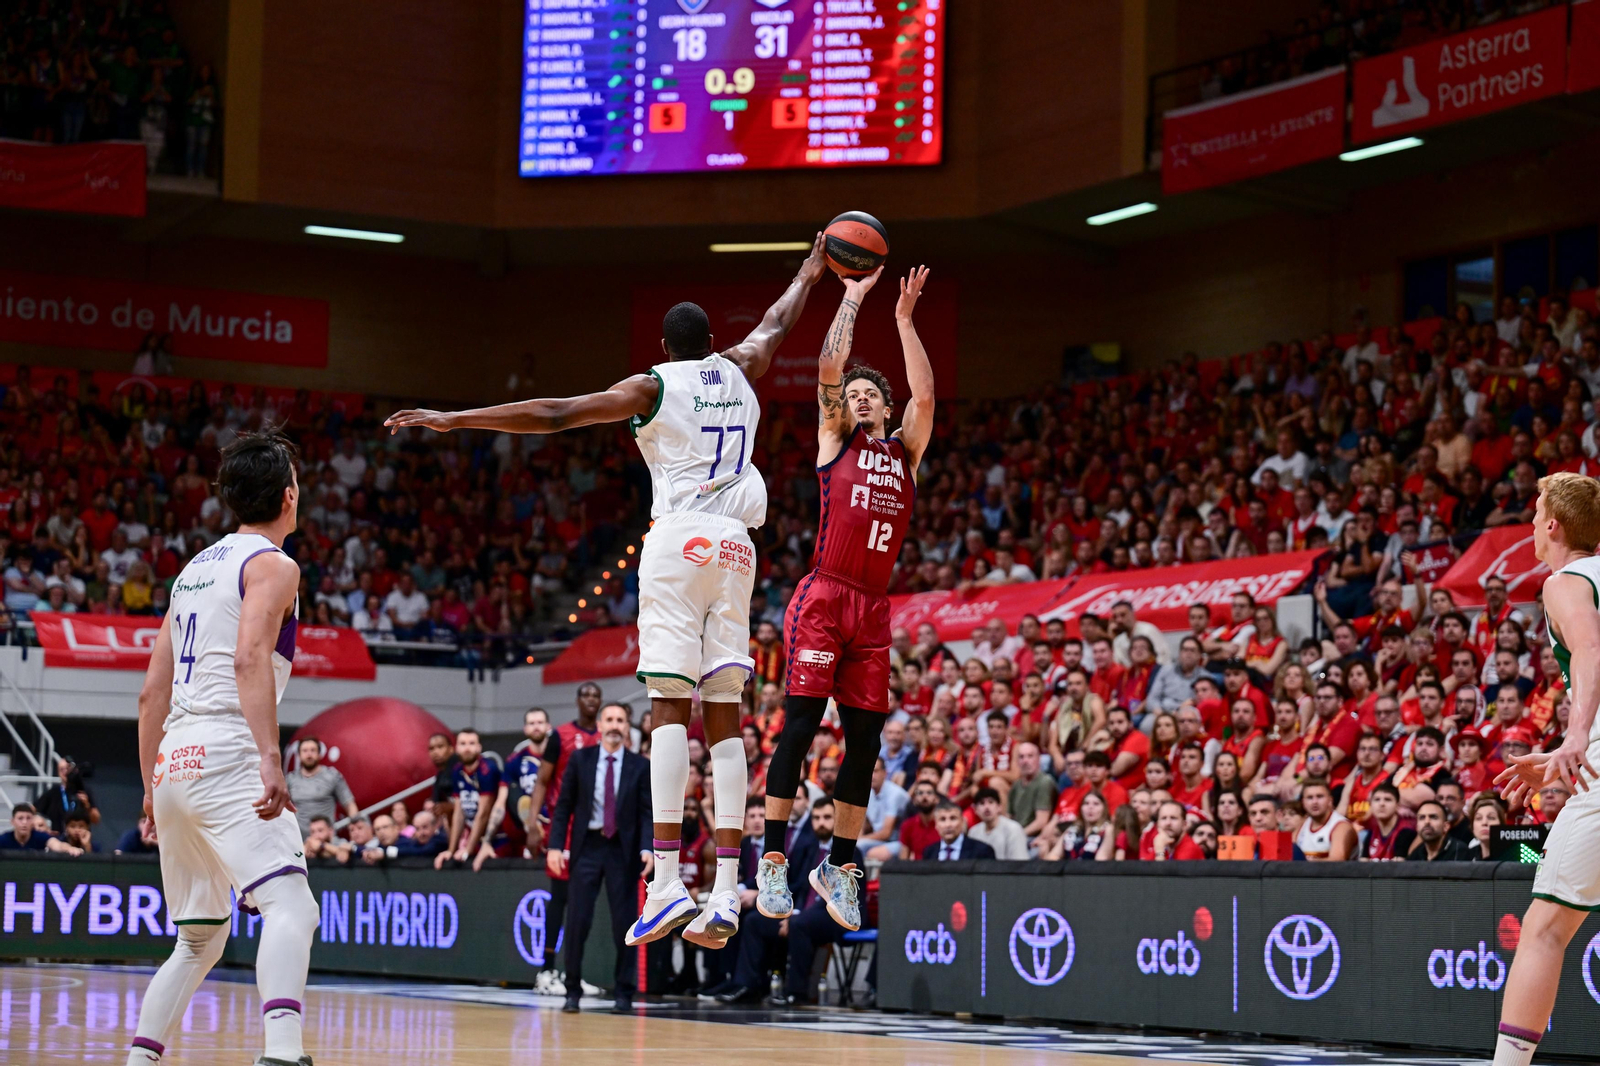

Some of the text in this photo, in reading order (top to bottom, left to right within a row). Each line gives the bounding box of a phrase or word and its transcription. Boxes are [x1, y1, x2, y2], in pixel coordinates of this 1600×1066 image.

[673, 28, 707, 61] 18
[754, 25, 789, 59] 31
[1439, 28, 1531, 73] Asterra
[704, 67, 755, 95] 0.9
[1438, 63, 1544, 112] Partners
[662, 107, 673, 126] 5
[723, 110, 734, 131] 1
[785, 103, 796, 122] 5
[111, 298, 155, 330] de
[168, 302, 292, 343] Murcia
[700, 370, 725, 386] SIM
[701, 425, 746, 480] 77
[720, 539, 753, 559] COSTA
[867, 519, 893, 553] 12
[717, 560, 750, 577] MÁLAGA
[719, 551, 752, 569] DEL SOL
[174, 612, 198, 685] 14
[169, 759, 204, 774] DEL SOL
[171, 745, 206, 761] COSTA
[1500, 828, 1540, 840] POSESIÓN
[3, 882, 178, 937] HYBRI
[355, 891, 459, 949] HYBRID
[905, 922, 957, 965] acb
[1136, 930, 1200, 977] acb
[1427, 940, 1507, 992] acb
